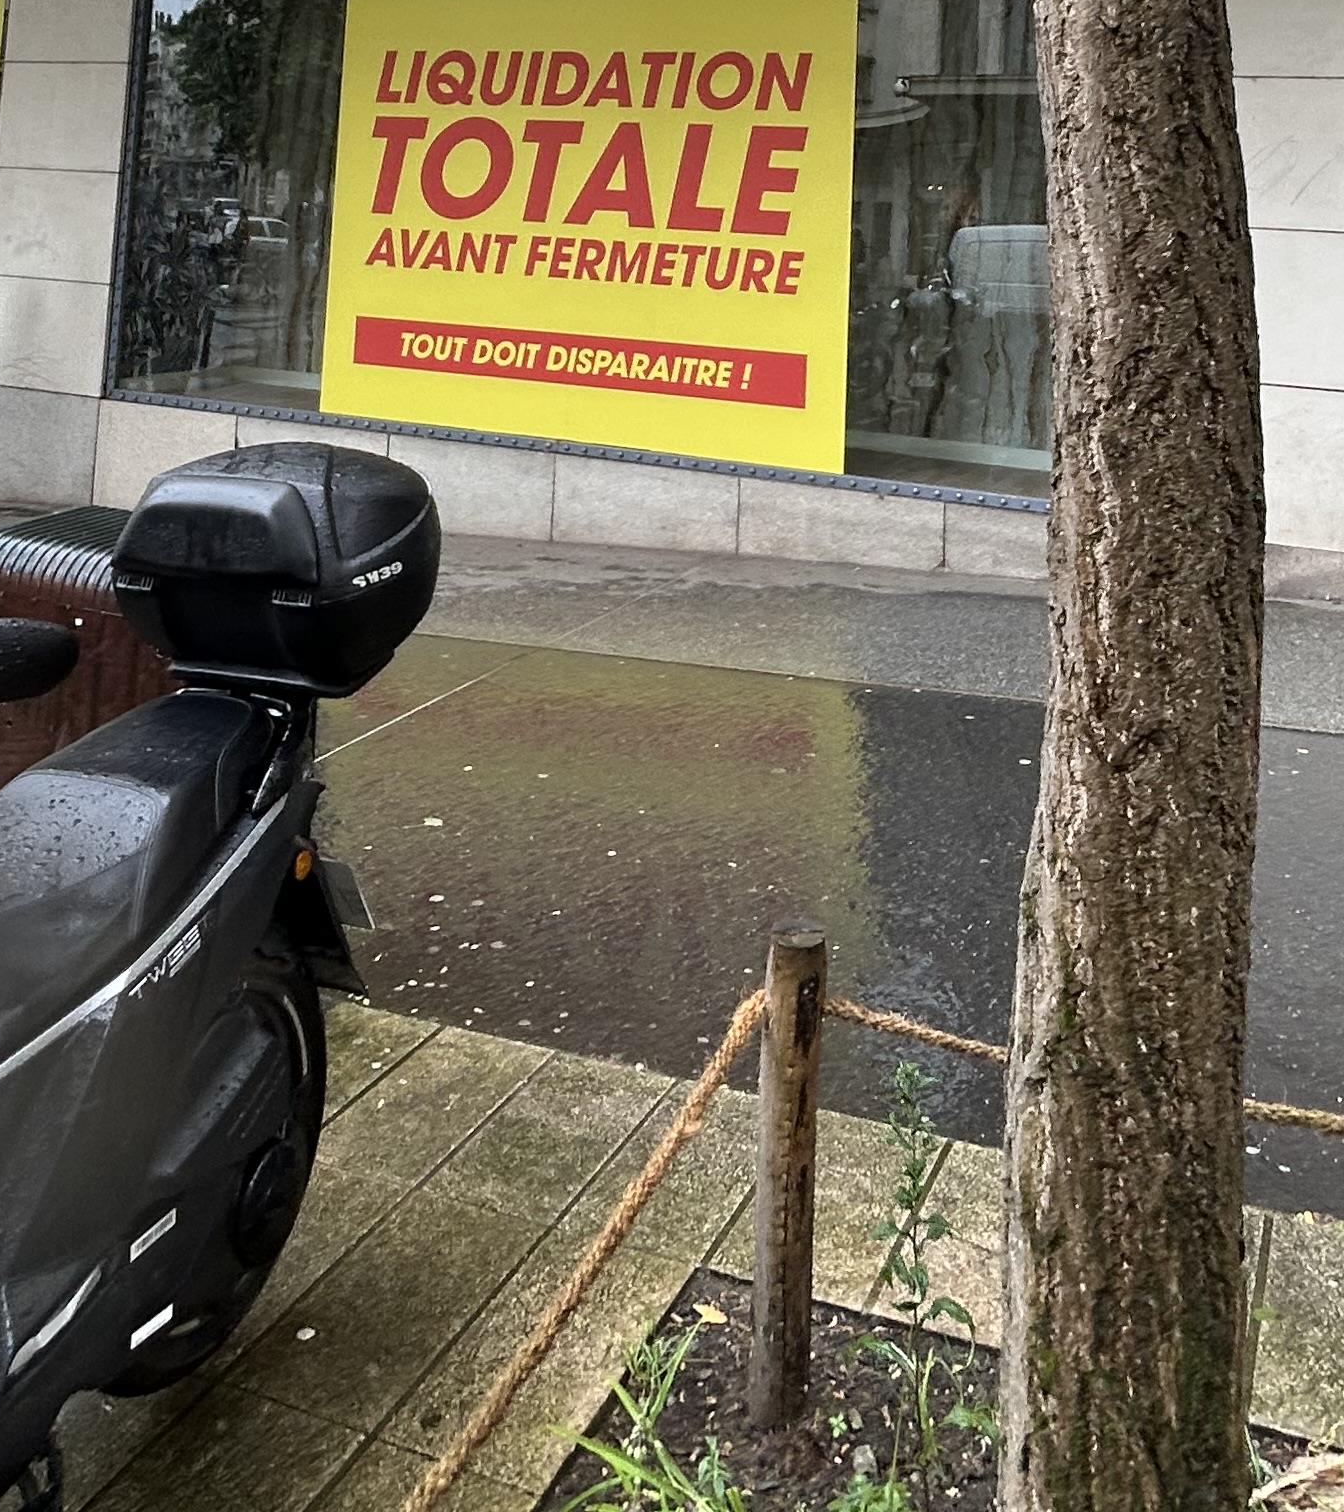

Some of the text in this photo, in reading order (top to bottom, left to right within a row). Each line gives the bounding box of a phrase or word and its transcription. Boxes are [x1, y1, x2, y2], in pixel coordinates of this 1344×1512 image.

[375, 50, 813, 111] LIQUIDATION
[371, 116, 809, 236] TOTALE
[365, 228, 805, 295] AVANT FERMETURE
[400, 332, 752, 390] TOUT DOIT DISPARAITRE !
